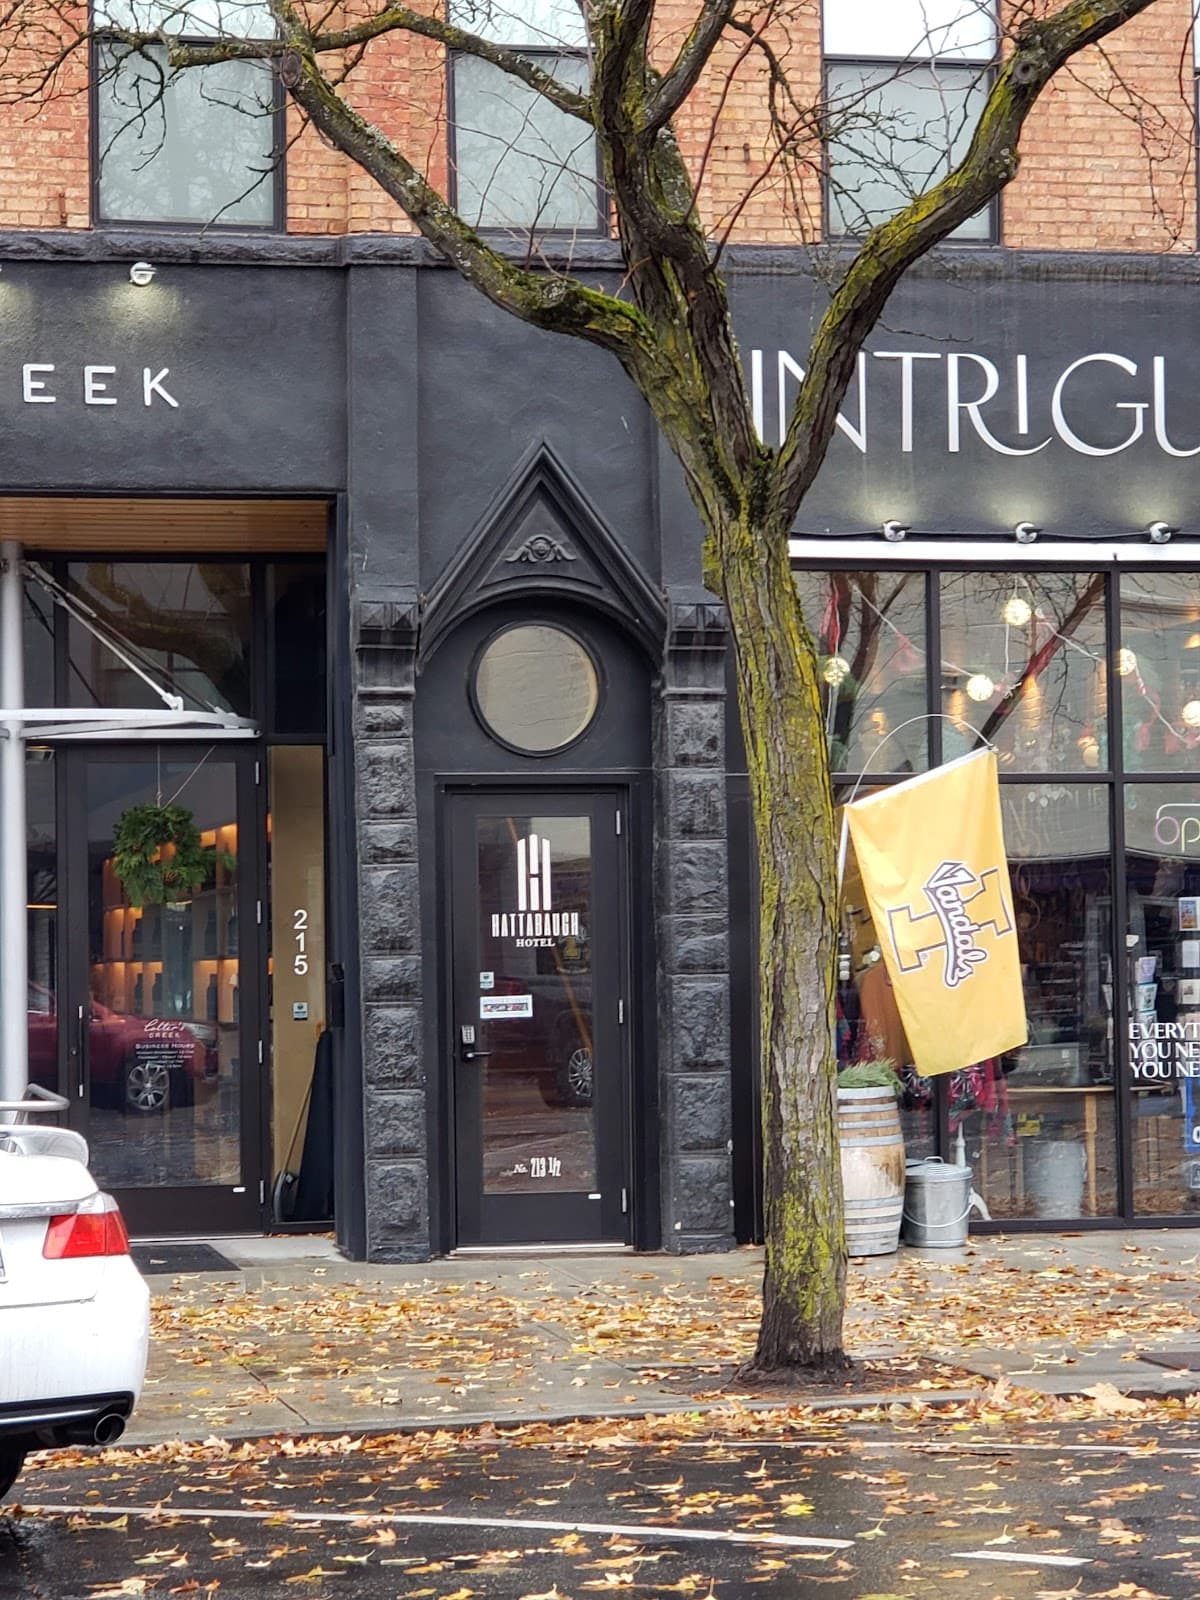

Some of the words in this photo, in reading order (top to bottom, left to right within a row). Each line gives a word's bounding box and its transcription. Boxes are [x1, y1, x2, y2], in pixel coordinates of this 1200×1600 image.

[22, 363, 179, 408] EEK
[751, 349, 1200, 457] INTRIGU
[491, 912, 579, 937] HATTABAUGH
[922, 861, 988, 988] Vandals
[293, 909, 308, 976] 215
[515, 938, 556, 948] HOTEL
[1128, 1041, 1171, 1059] YOU
[1129, 1061, 1172, 1079] YOU
